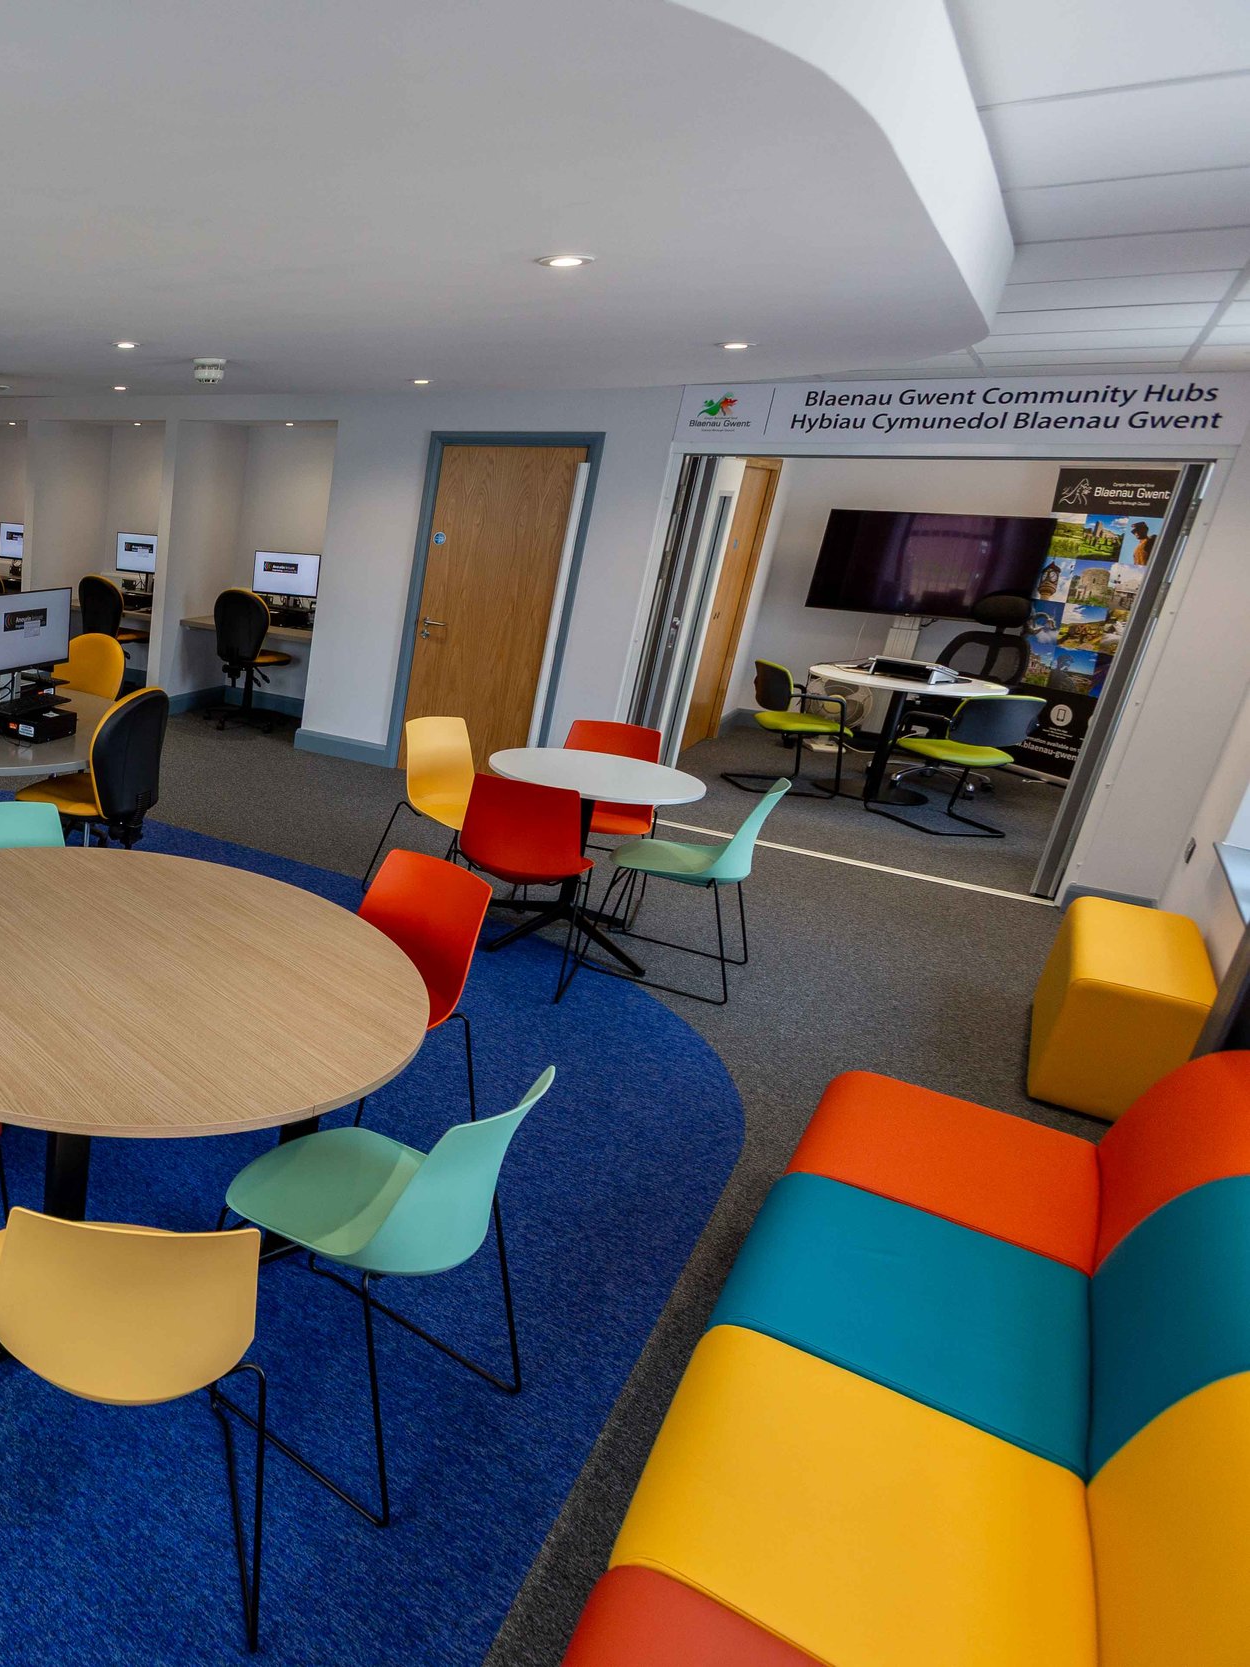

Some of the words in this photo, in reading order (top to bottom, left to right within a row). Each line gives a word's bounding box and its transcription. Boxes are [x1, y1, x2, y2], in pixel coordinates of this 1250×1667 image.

[804, 390, 892, 407] Blaenau
[898, 388, 976, 406] Gwent
[982, 384, 1138, 407] Community
[1143, 382, 1219, 402] Hubs
[689, 419, 721, 427] Blaenau
[723, 419, 752, 427] Gwent
[790, 413, 866, 433] Hybiau
[872, 411, 1008, 433] Cymunedol
[1013, 411, 1120, 429] Blaenau
[1127, 411, 1222, 429] Gwent
[1094, 487, 1134, 498] Blaenau
[1137, 488, 1171, 499] Gwent
[1026, 736, 1046, 744] mation
